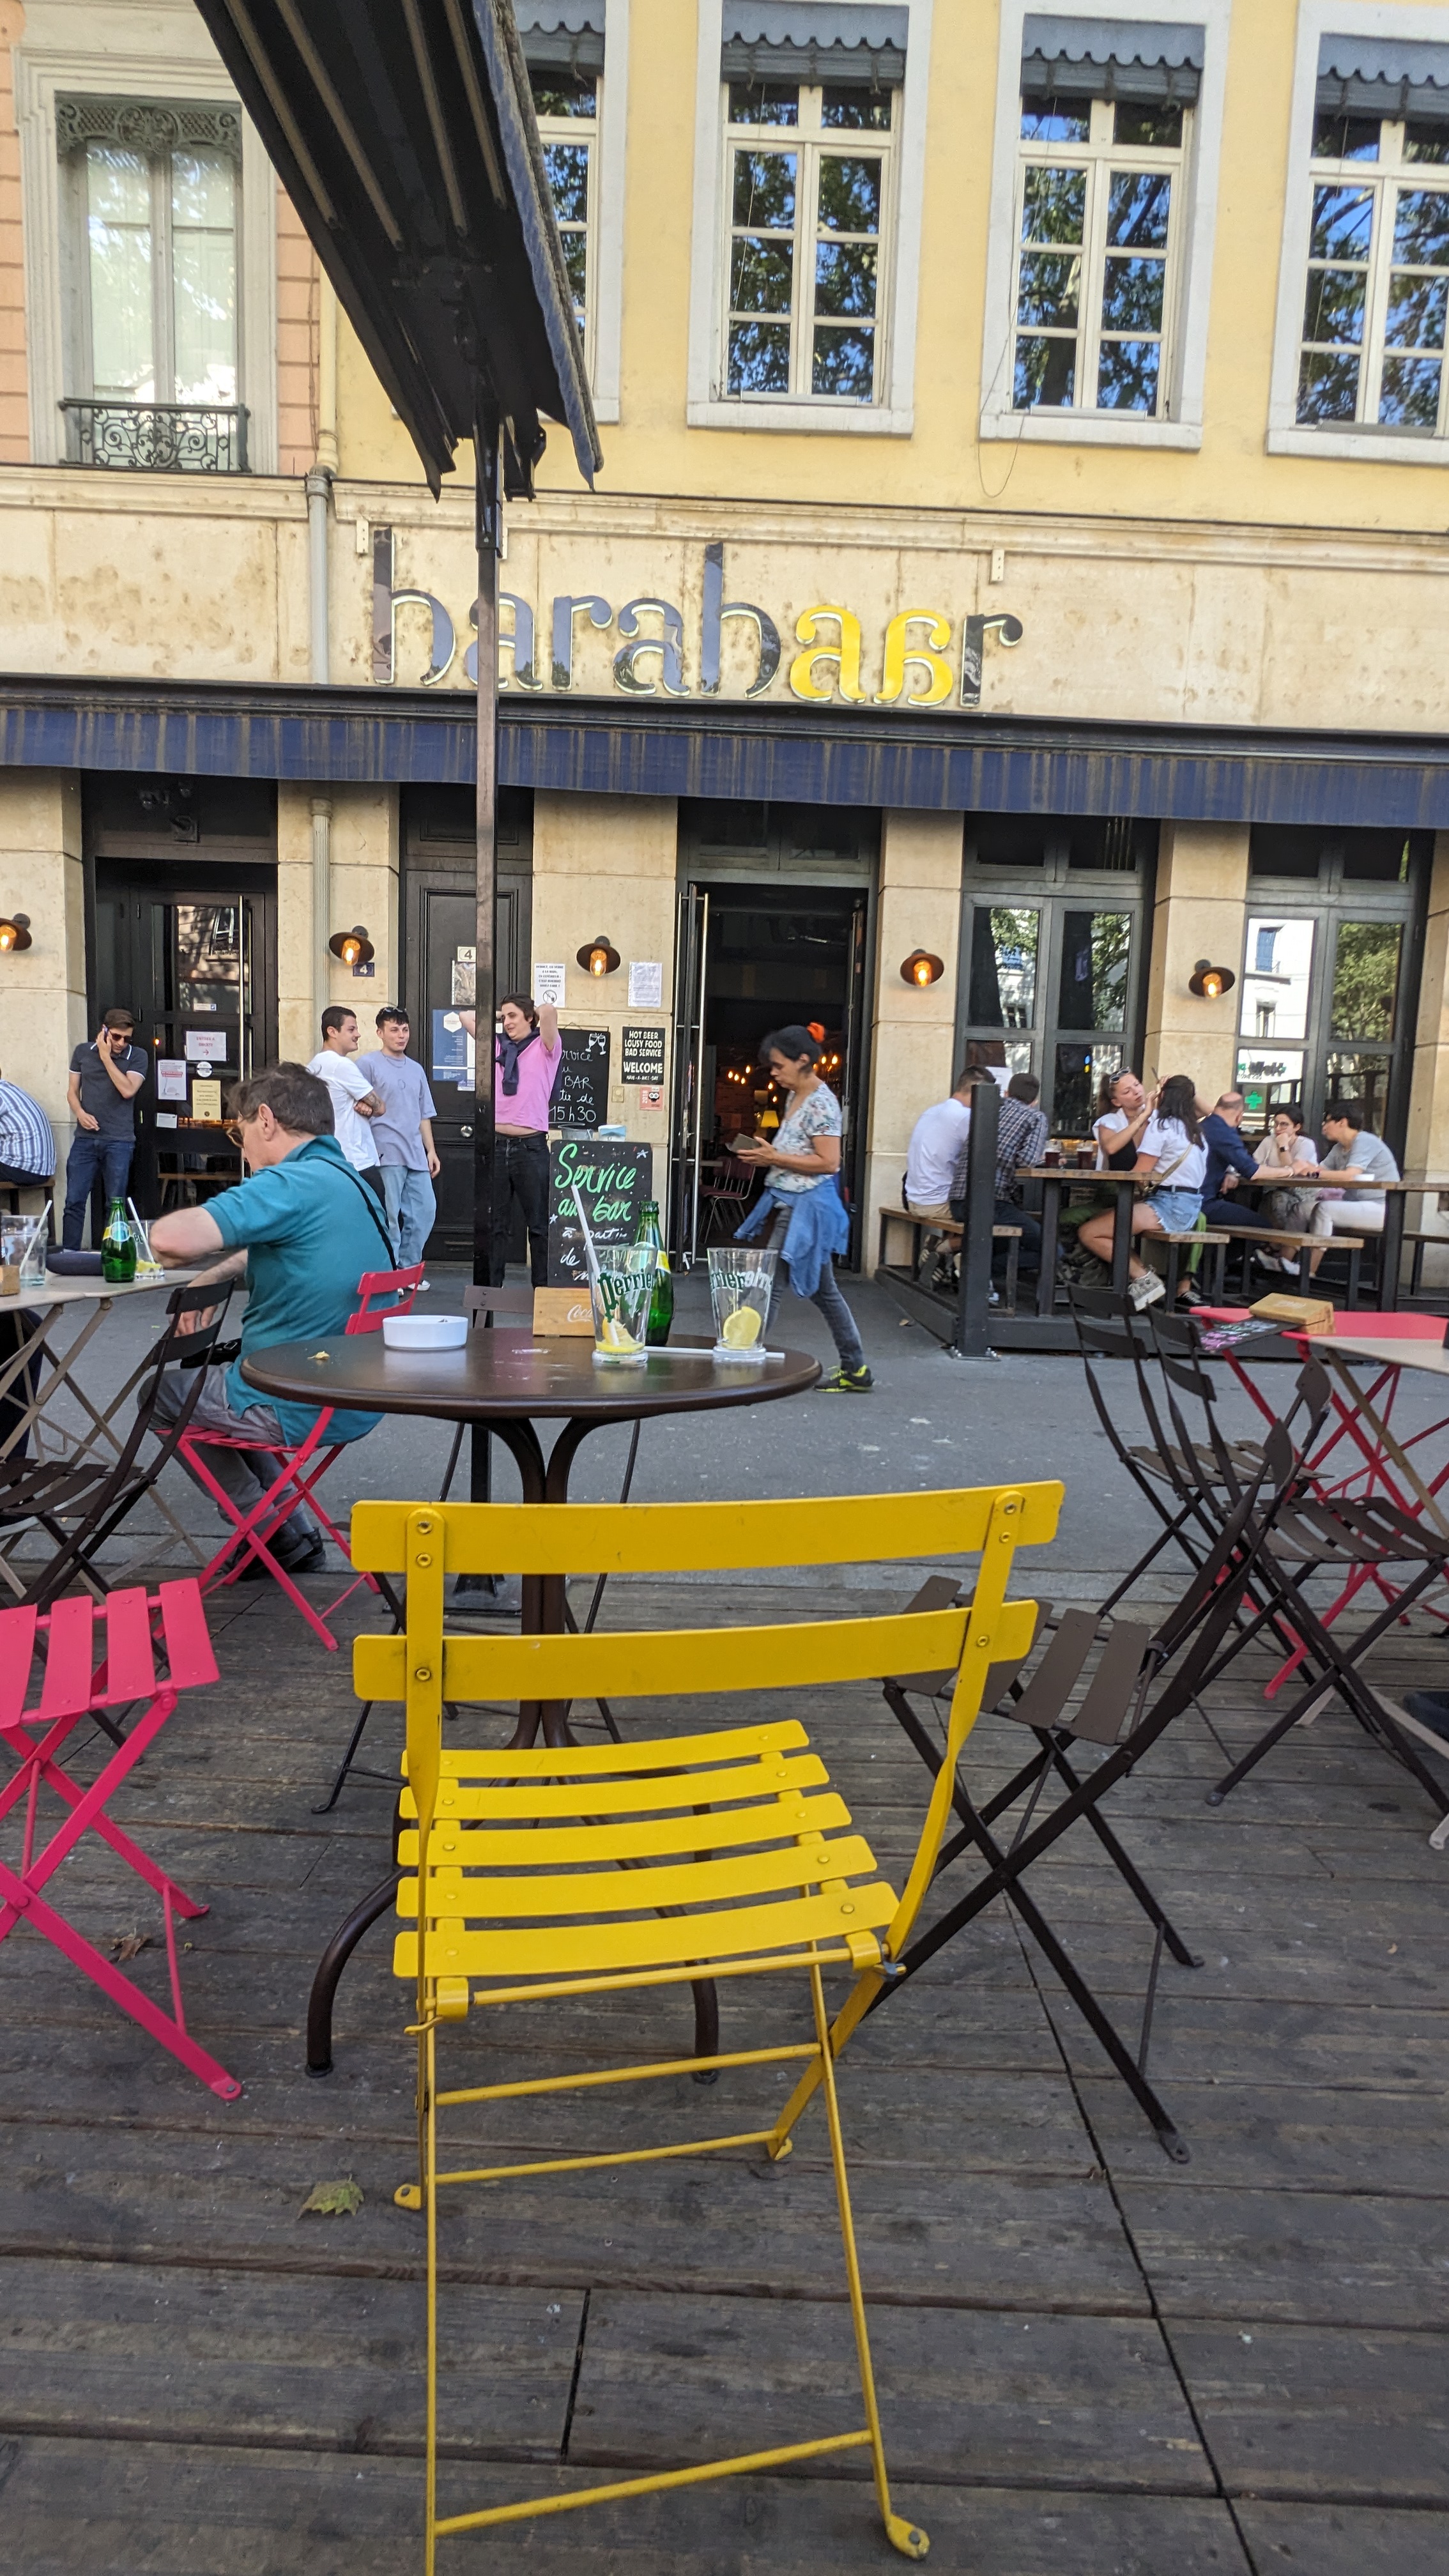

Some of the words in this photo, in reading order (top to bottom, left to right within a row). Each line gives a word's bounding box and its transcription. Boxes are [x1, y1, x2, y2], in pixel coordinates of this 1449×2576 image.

[464, 949, 473, 960] 4
[360, 964, 368, 974] 4
[629, 1031, 642, 1039] HOT
[643, 1031, 659, 1039] BEER
[624, 1039, 644, 1048] LOUSY
[645, 1040, 663, 1048] FOOD
[562, 1050, 594, 1062] rvice
[625, 1048, 638, 1056] BAD
[639, 1048, 662, 1057] SERVICE
[623, 1061, 663, 1073] WELCOME
[564, 1075, 594, 1090] BAR
[576, 1093, 594, 1105] de
[555, 1143, 637, 1193] Service
[558, 1198, 578, 1217] au
[592, 1195, 632, 1223] bar
[560, 1246, 580, 1266] de
